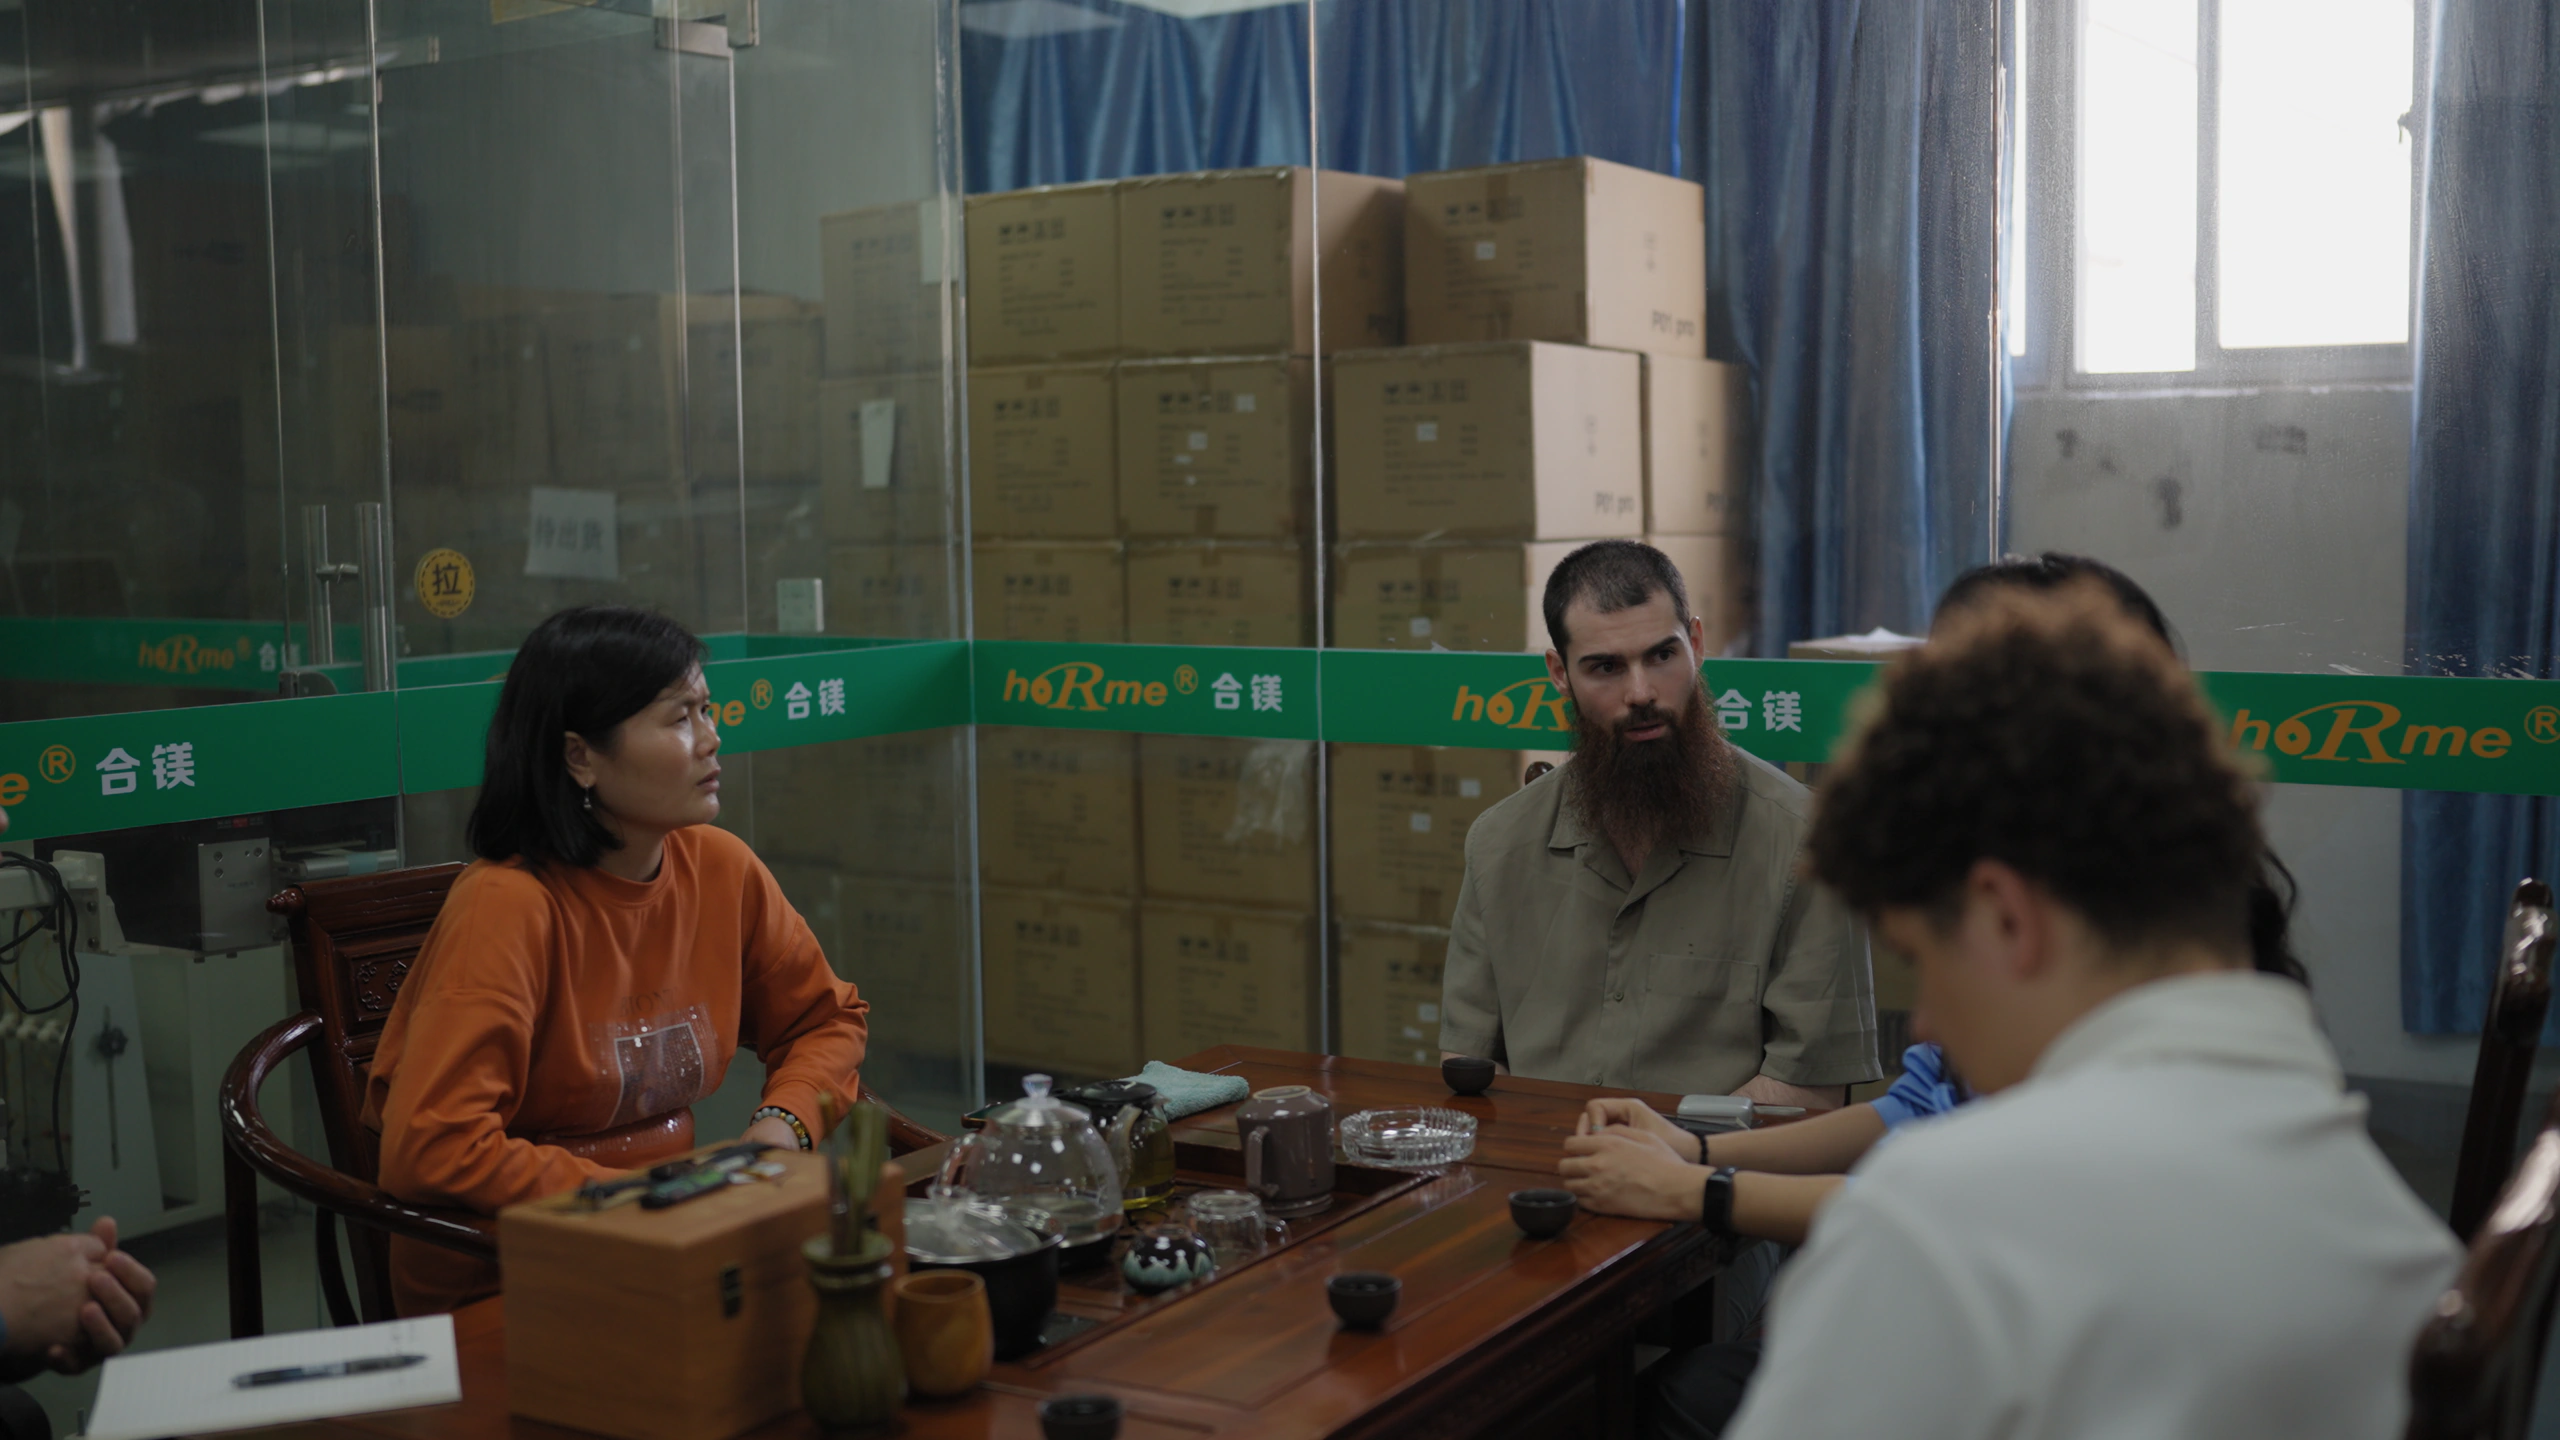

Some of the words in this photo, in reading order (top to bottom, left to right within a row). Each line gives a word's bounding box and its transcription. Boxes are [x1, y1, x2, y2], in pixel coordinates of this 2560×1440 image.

[432, 562, 462, 596] 拉
[784, 678, 846, 721] 合镁
[1211, 672, 1283, 712] 合镁
[1714, 688, 1803, 733] 合镁
[95, 741, 196, 796] 合镁
